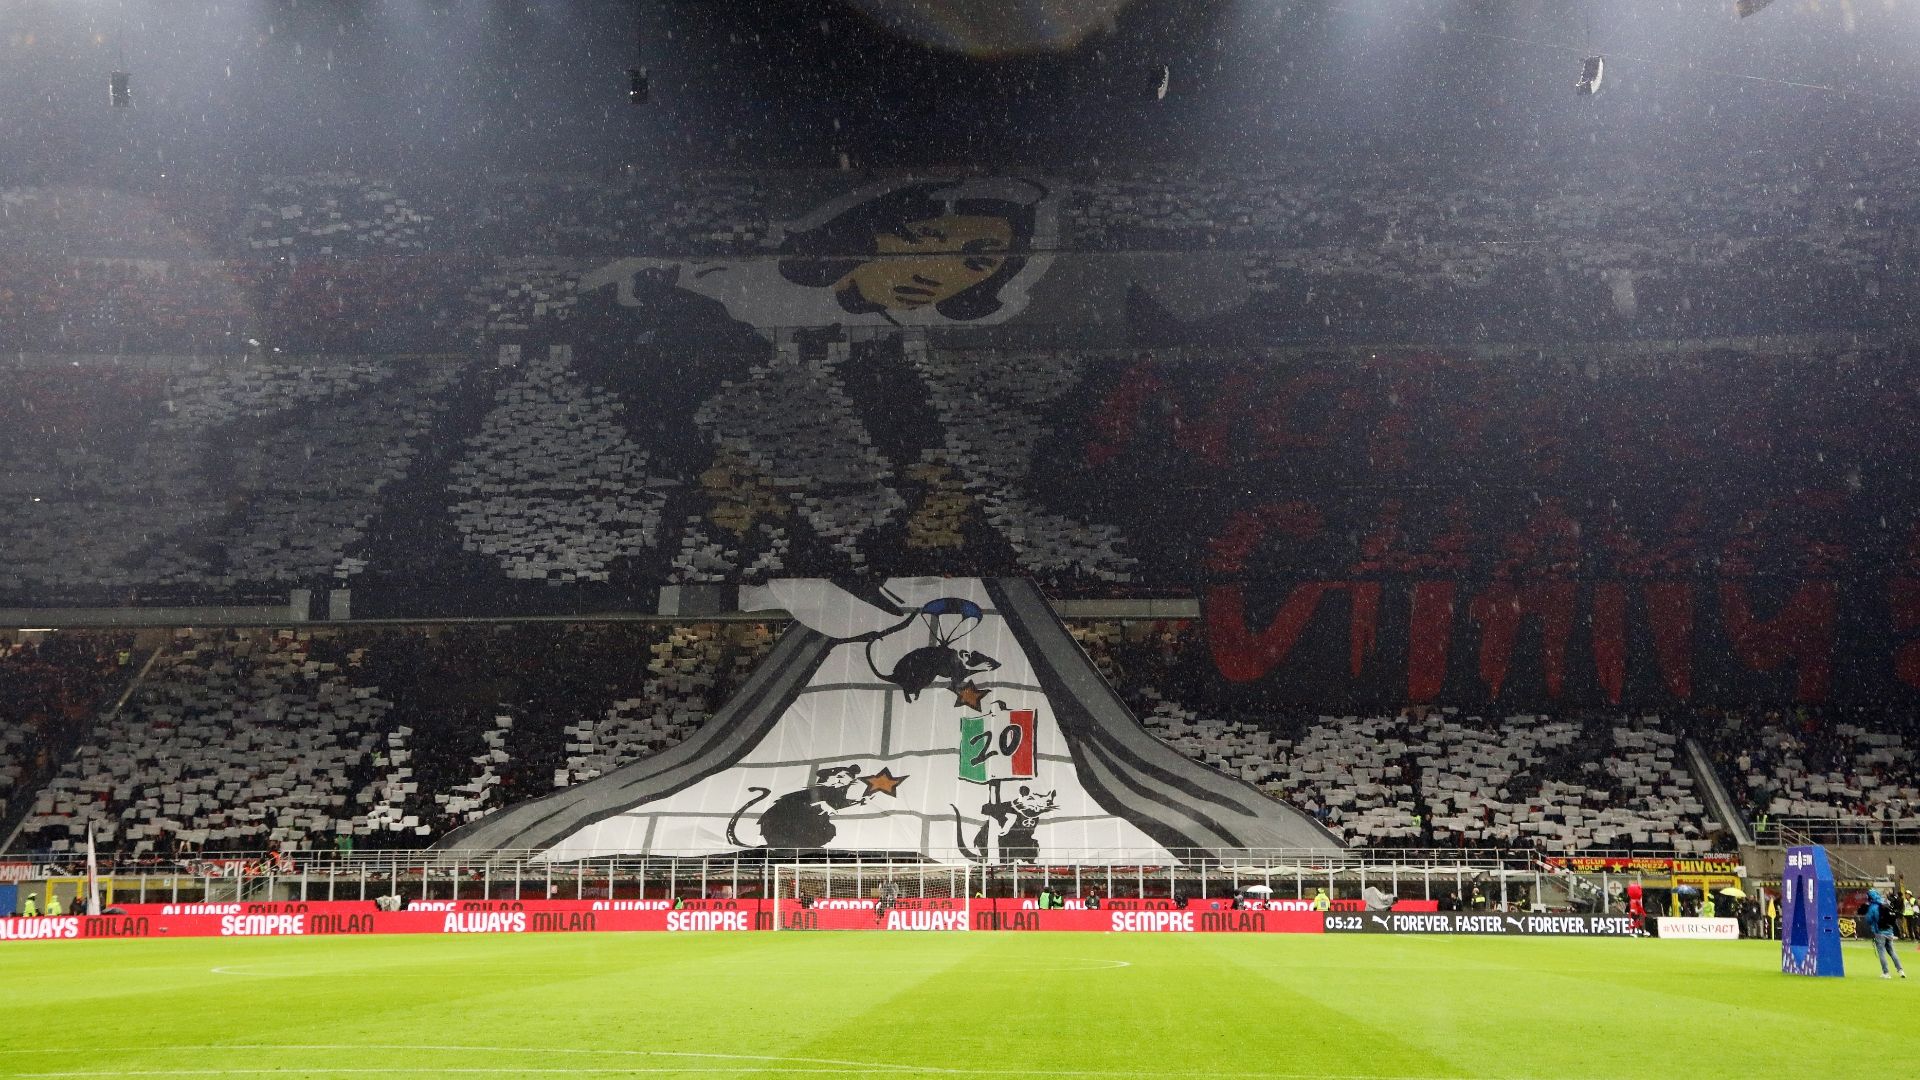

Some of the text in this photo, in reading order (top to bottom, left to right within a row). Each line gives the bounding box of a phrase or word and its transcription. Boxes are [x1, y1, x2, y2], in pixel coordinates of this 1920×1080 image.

[1204, 492, 1920, 704] CHANG
[970, 725, 1022, 766] 20
[0, 917, 149, 938] ALWAYS MILAN
[221, 914, 375, 935] SEMPRE MILAN
[443, 912, 596, 933] ALWAYS MILAN
[666, 911, 818, 931] SEMPRE MLAN
[887, 910, 1039, 931] ALWAYS MILAN
[1111, 911, 1265, 932] SEMPRE MILAN
[1326, 916, 1363, 929] 05:22
[1393, 915, 1506, 932] FOREVER. FASTER.
[1528, 916, 1588, 933] FOREVER.
